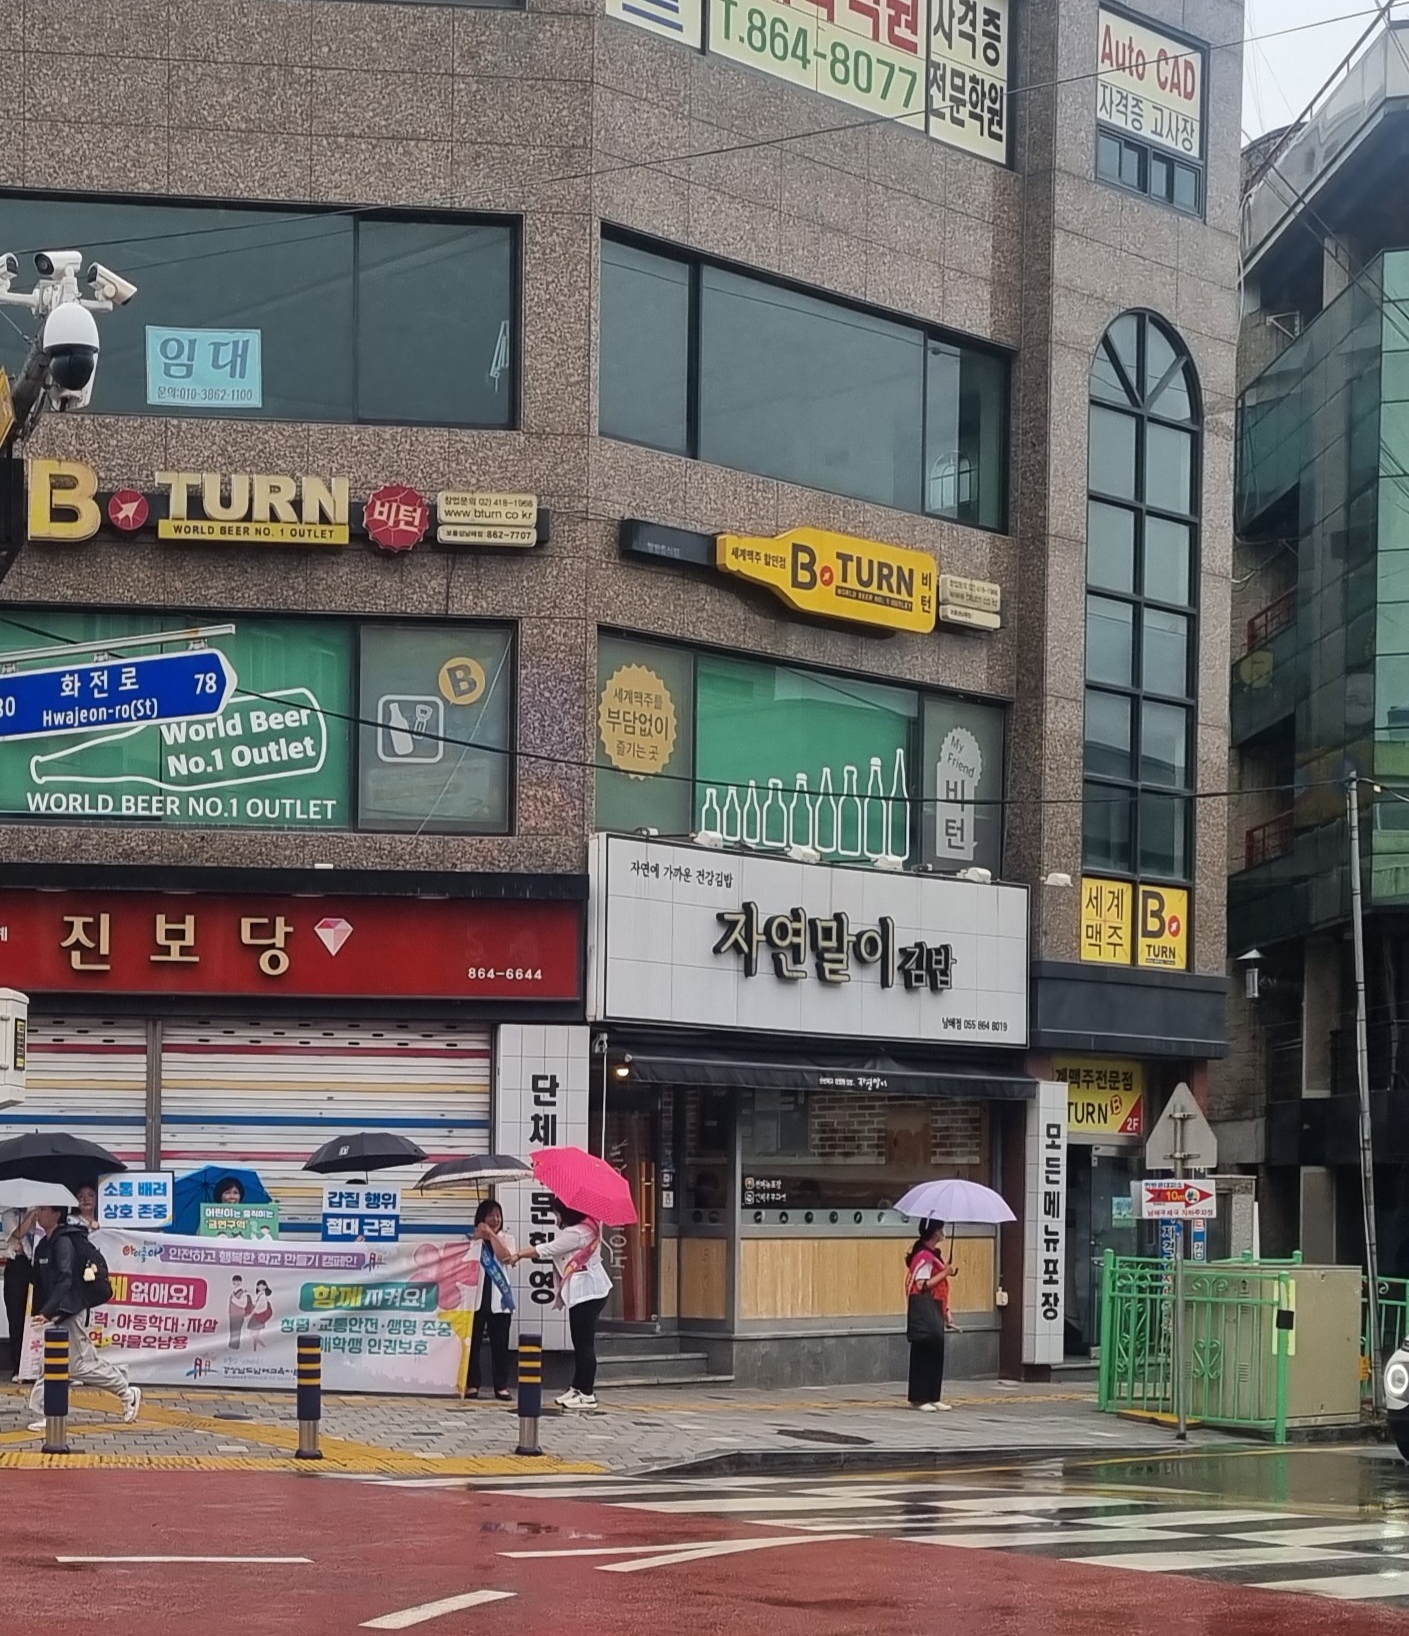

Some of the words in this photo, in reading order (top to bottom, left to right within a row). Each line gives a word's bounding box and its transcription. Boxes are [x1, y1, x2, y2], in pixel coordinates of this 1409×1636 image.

[1101, 24, 1146, 81] Auto
[1157, 48, 1195, 100] CAD
[930, 60, 1003, 142] 전문학원
[1099, 84, 1143, 131] 자격증
[1151, 105, 1195, 152] 고사장
[155, 471, 349, 524] TURN
[373, 502, 421, 532] 비턴
[173, 525, 214, 535] WORLD
[220, 527, 250, 536] BEER
[290, 528, 334, 539] OUTLET
[731, 547, 761, 563] 세계맥주
[836, 551, 914, 598] TURN
[60, 667, 139, 698] 화전로
[194, 672, 217, 695] 78
[446, 664, 477, 698] B
[43, 697, 158, 727] Hwajeon-ro(St)
[606, 707, 668, 741] 부담없이
[160, 713, 241, 745] World
[249, 707, 312, 733] Beer
[167, 749, 224, 777] No.1
[231, 735, 317, 767] Outlet
[649, 745, 658, 761] 곳
[950, 736, 965, 753] My
[947, 752, 975, 778] Friend
[26, 793, 114, 814] WORLD
[122, 795, 180, 816] BEER
[188, 797, 238, 817] NO.1
[246, 799, 337, 819] OUTLET
[631, 860, 659, 879] 자연에
[663, 864, 692, 883] 가까운
[696, 869, 733, 888] 건강김밥
[1086, 885, 1124, 921] 세계
[1142, 890, 1165, 939] B
[712, 901, 895, 989] 자연말이
[897, 941, 957, 990] 김밥
[1086, 923, 1123, 958] 맥주
[1146, 944, 1175, 960] TURN
[468, 967, 543, 981] 864-6644
[1127, 1118, 1139, 1131] 2F
[104, 1181, 133, 1197] 소통
[138, 1181, 167, 1197] 배려
[327, 1192, 359, 1208] 갑질
[365, 1192, 397, 1209] 행위
[103, 1204, 133, 1219] 상호
[138, 1204, 167, 1219] 존중
[205, 1208, 240, 1218] 어린이는
[327, 1219, 358, 1235] 절대
[363, 1219, 396, 1236] 근절
[169, 1247, 216, 1263] 안전하고
[219, 1250, 255, 1264] 행복한
[257, 1251, 281, 1265] 학교
[284, 1252, 319, 1267] 만들기
[131, 1281, 194, 1305] 없애요!
[312, 1285, 362, 1309] 함께
[364, 1288, 426, 1308] 지켜요!
[422, 1320, 452, 1337] 존중
[368, 1338, 428, 1355] 인권보호
